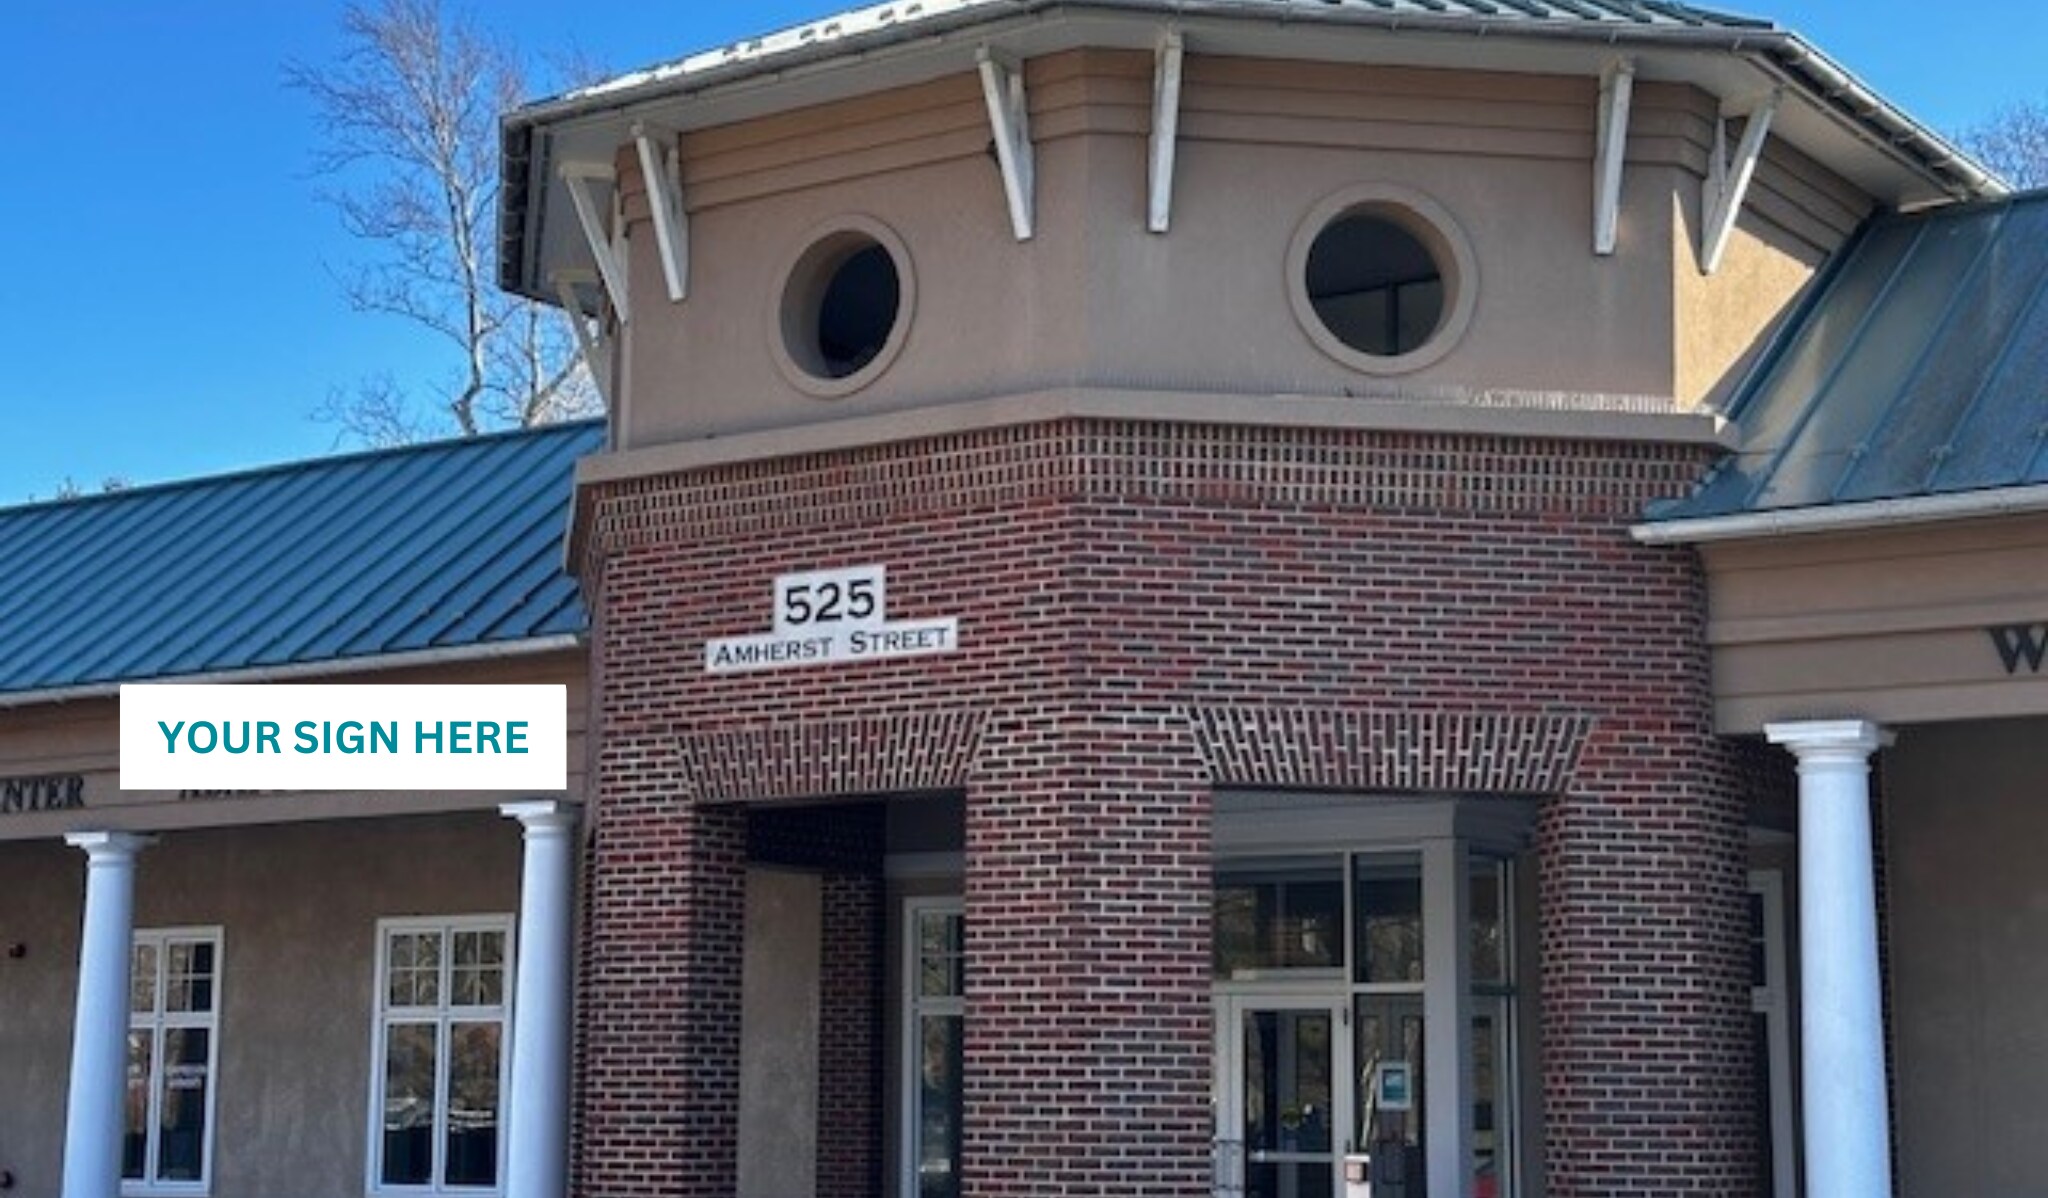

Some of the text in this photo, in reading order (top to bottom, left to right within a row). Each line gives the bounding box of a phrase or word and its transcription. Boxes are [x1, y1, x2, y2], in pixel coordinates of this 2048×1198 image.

[784, 578, 875, 625] 525
[713, 627, 949, 666] AMHERST STREET
